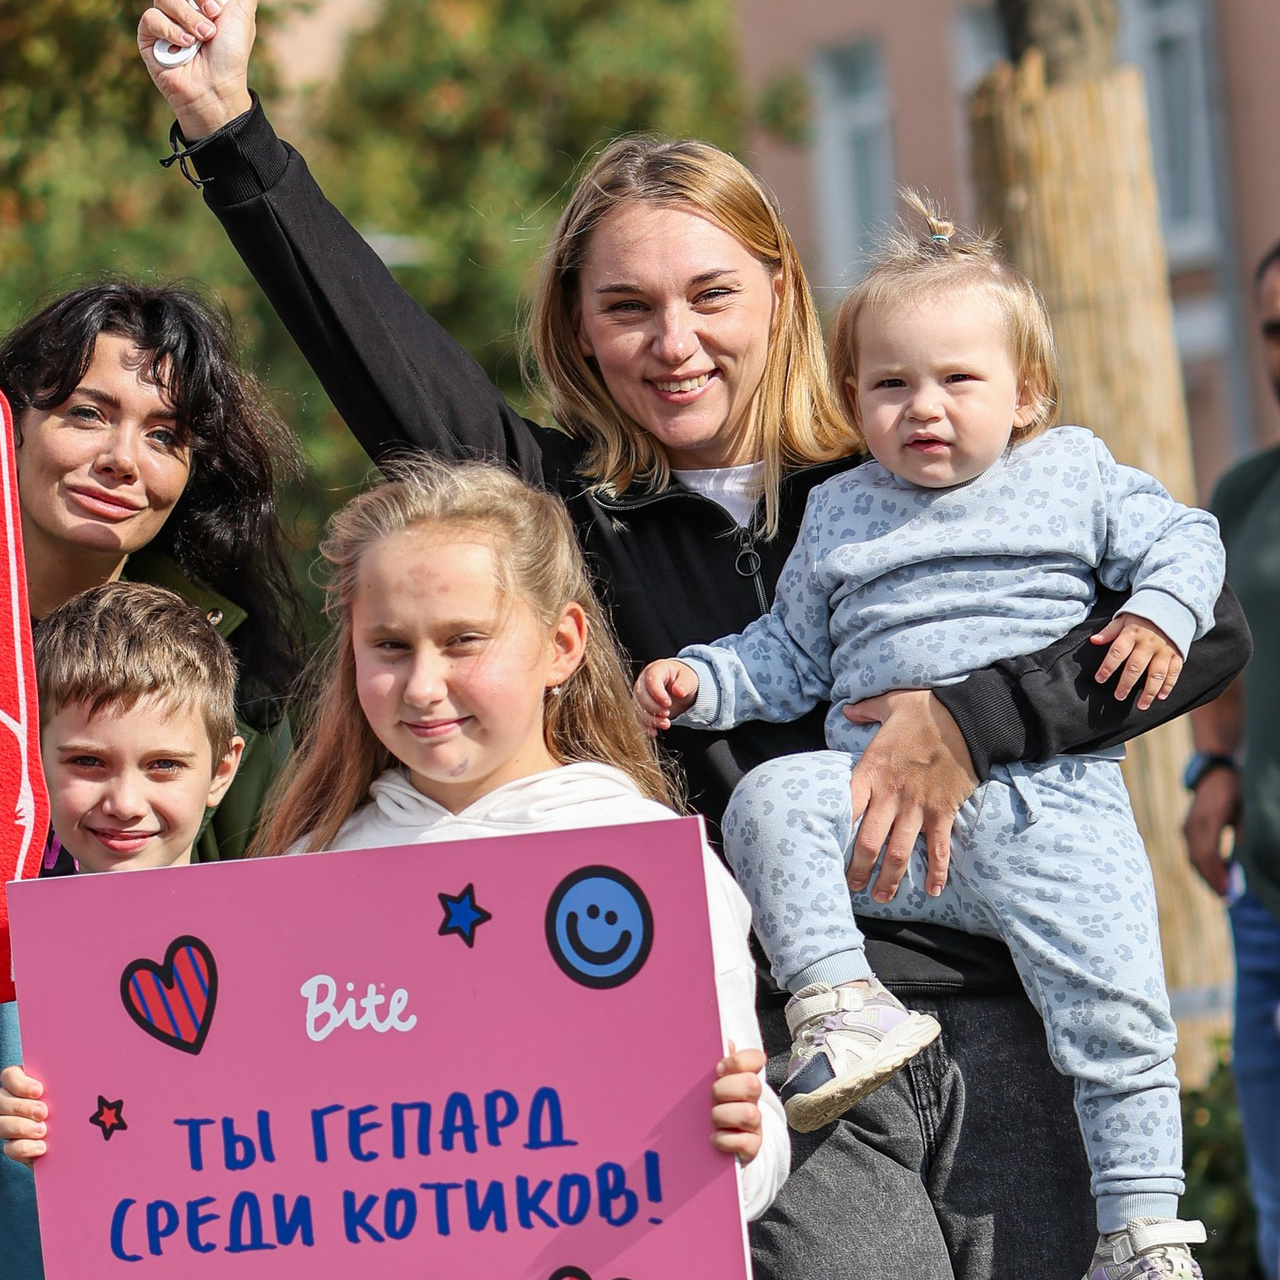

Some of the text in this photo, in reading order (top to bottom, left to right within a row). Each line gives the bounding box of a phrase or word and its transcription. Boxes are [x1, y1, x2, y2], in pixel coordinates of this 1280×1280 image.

[300, 974, 418, 1042] Bite
[175, 1087, 577, 1171] ТЫ ГЕПАРД
[110, 1151, 662, 1262] СРЕДИ КОТИКОВ!
